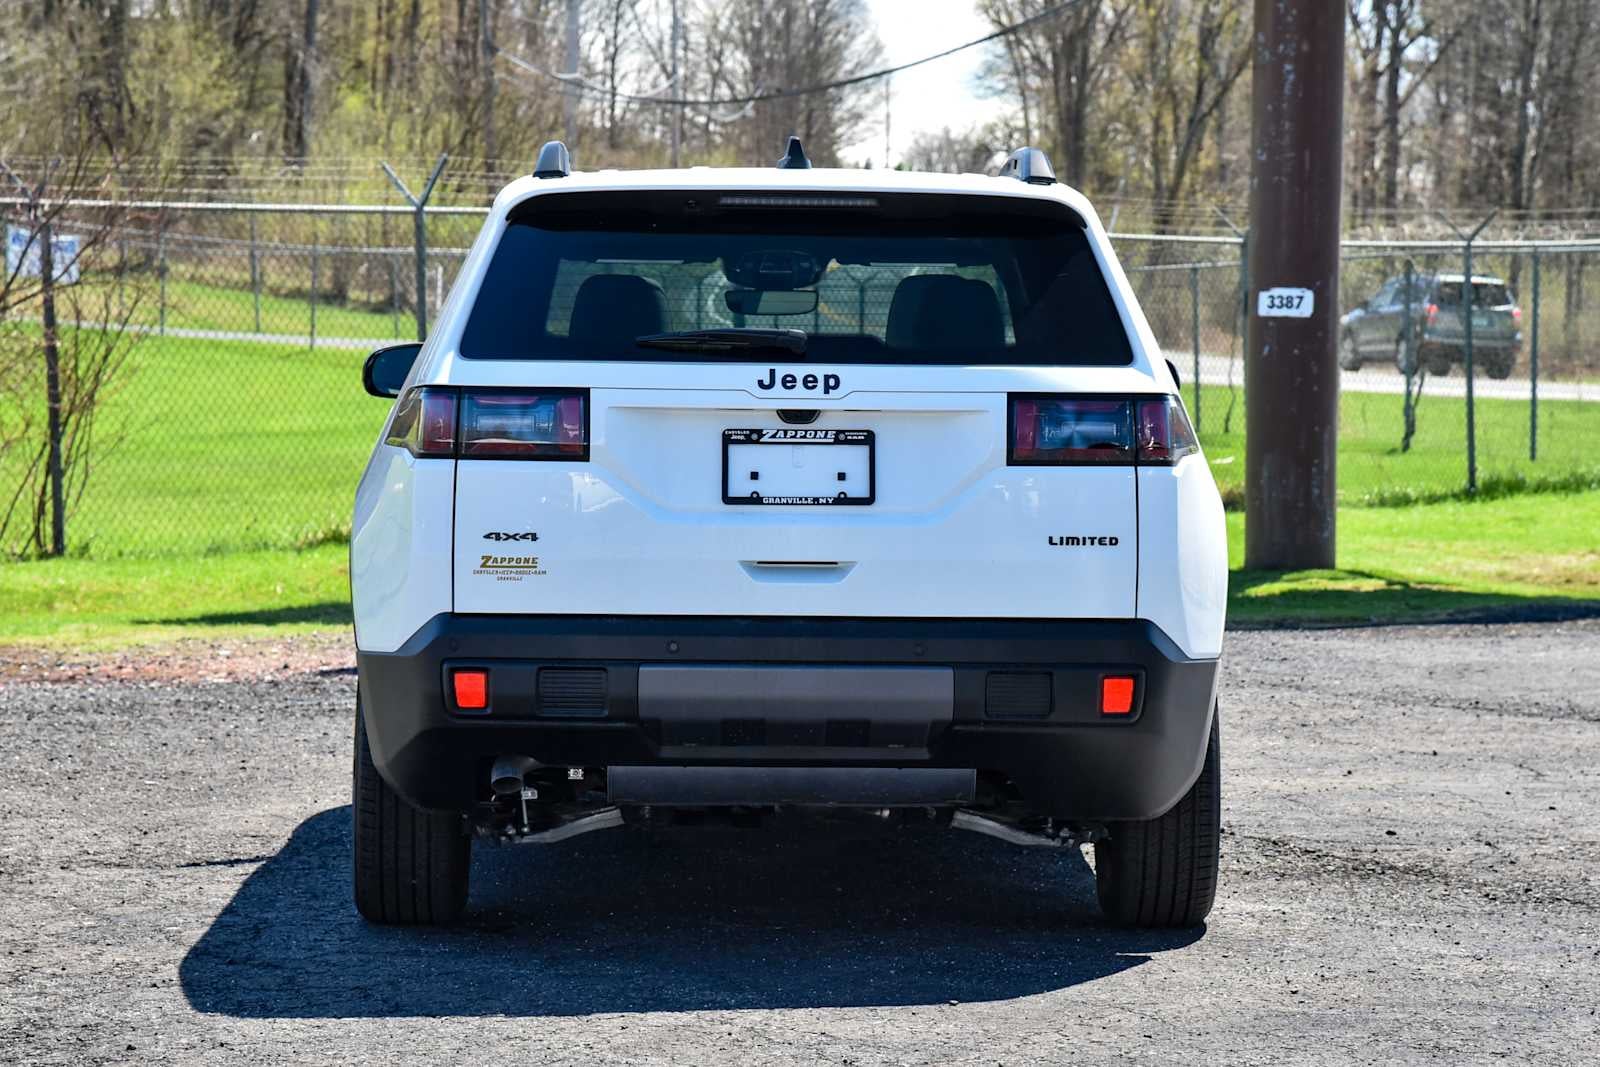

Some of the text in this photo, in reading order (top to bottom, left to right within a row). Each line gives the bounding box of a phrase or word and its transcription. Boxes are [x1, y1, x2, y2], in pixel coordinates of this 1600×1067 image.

[1267, 295, 1304, 310] 3387
[757, 368, 841, 394] Jeep
[759, 429, 837, 443] ZAPPONE
[1048, 535, 1119, 546] LIMITED
[480, 555, 539, 568] ZAPPONE
